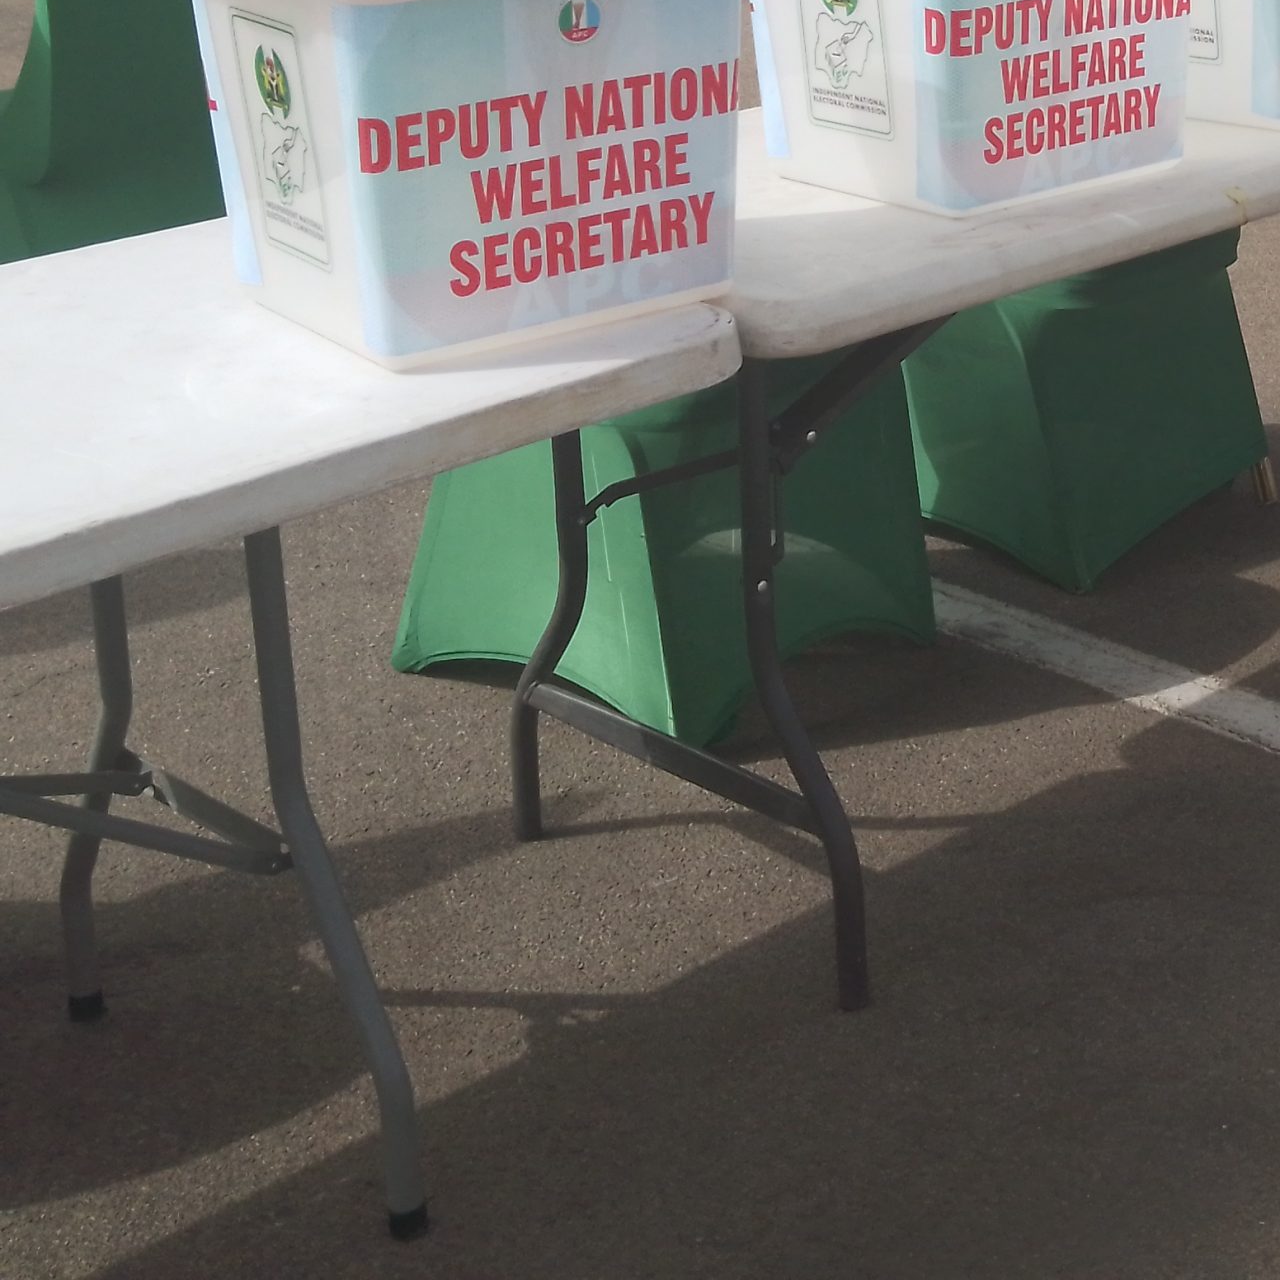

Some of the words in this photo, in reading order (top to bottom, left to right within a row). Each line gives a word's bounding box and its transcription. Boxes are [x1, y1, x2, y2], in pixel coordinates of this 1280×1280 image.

[1000, 33, 1147, 105] WELFARE
[356, 90, 548, 175] DEPUTY
[983, 83, 1162, 165] SECRETARY
[470, 131, 692, 225] WELFARE
[448, 191, 717, 300] SECRETARY
